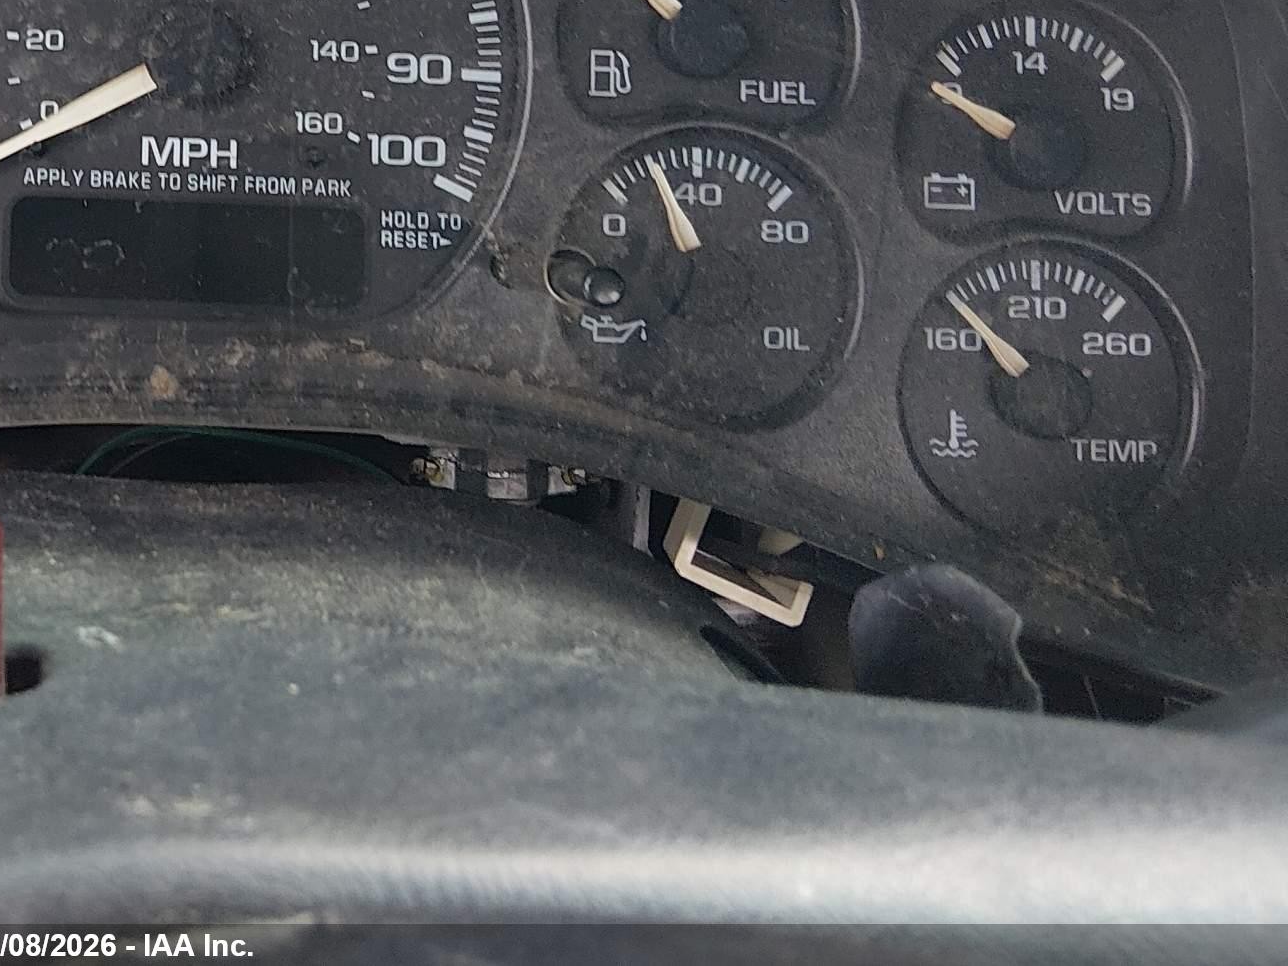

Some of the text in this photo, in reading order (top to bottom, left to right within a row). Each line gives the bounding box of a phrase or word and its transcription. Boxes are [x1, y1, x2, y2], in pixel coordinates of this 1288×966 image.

[25, 29, 65, 51] 20
[311, 40, 360, 64] 140
[386, 53, 452, 85] 90
[1013, 51, 1047, 75] 14
[739, 80, 815, 106] FUEL
[1101, 87, 1134, 111] 19
[295, 111, 343, 135] 160
[140, 136, 239, 169] MPH
[368, 135, 447, 167] 100
[23, 170, 352, 197] APPLY BRAKE TO SHIFT FROM PARK
[674, 183, 722, 206] 40
[1054, 191, 1152, 217] VOLTS
[380, 210, 462, 230] HOLD TO
[603, 214, 625, 236] 0
[761, 220, 809, 244] 80
[380, 231, 439, 249] RESET
[1008, 296, 1066, 320] 210
[763, 327, 810, 351] OIL
[924, 327, 982, 351] 160
[1082, 333, 1151, 356] 260
[1070, 439, 1157, 463] TEMP
